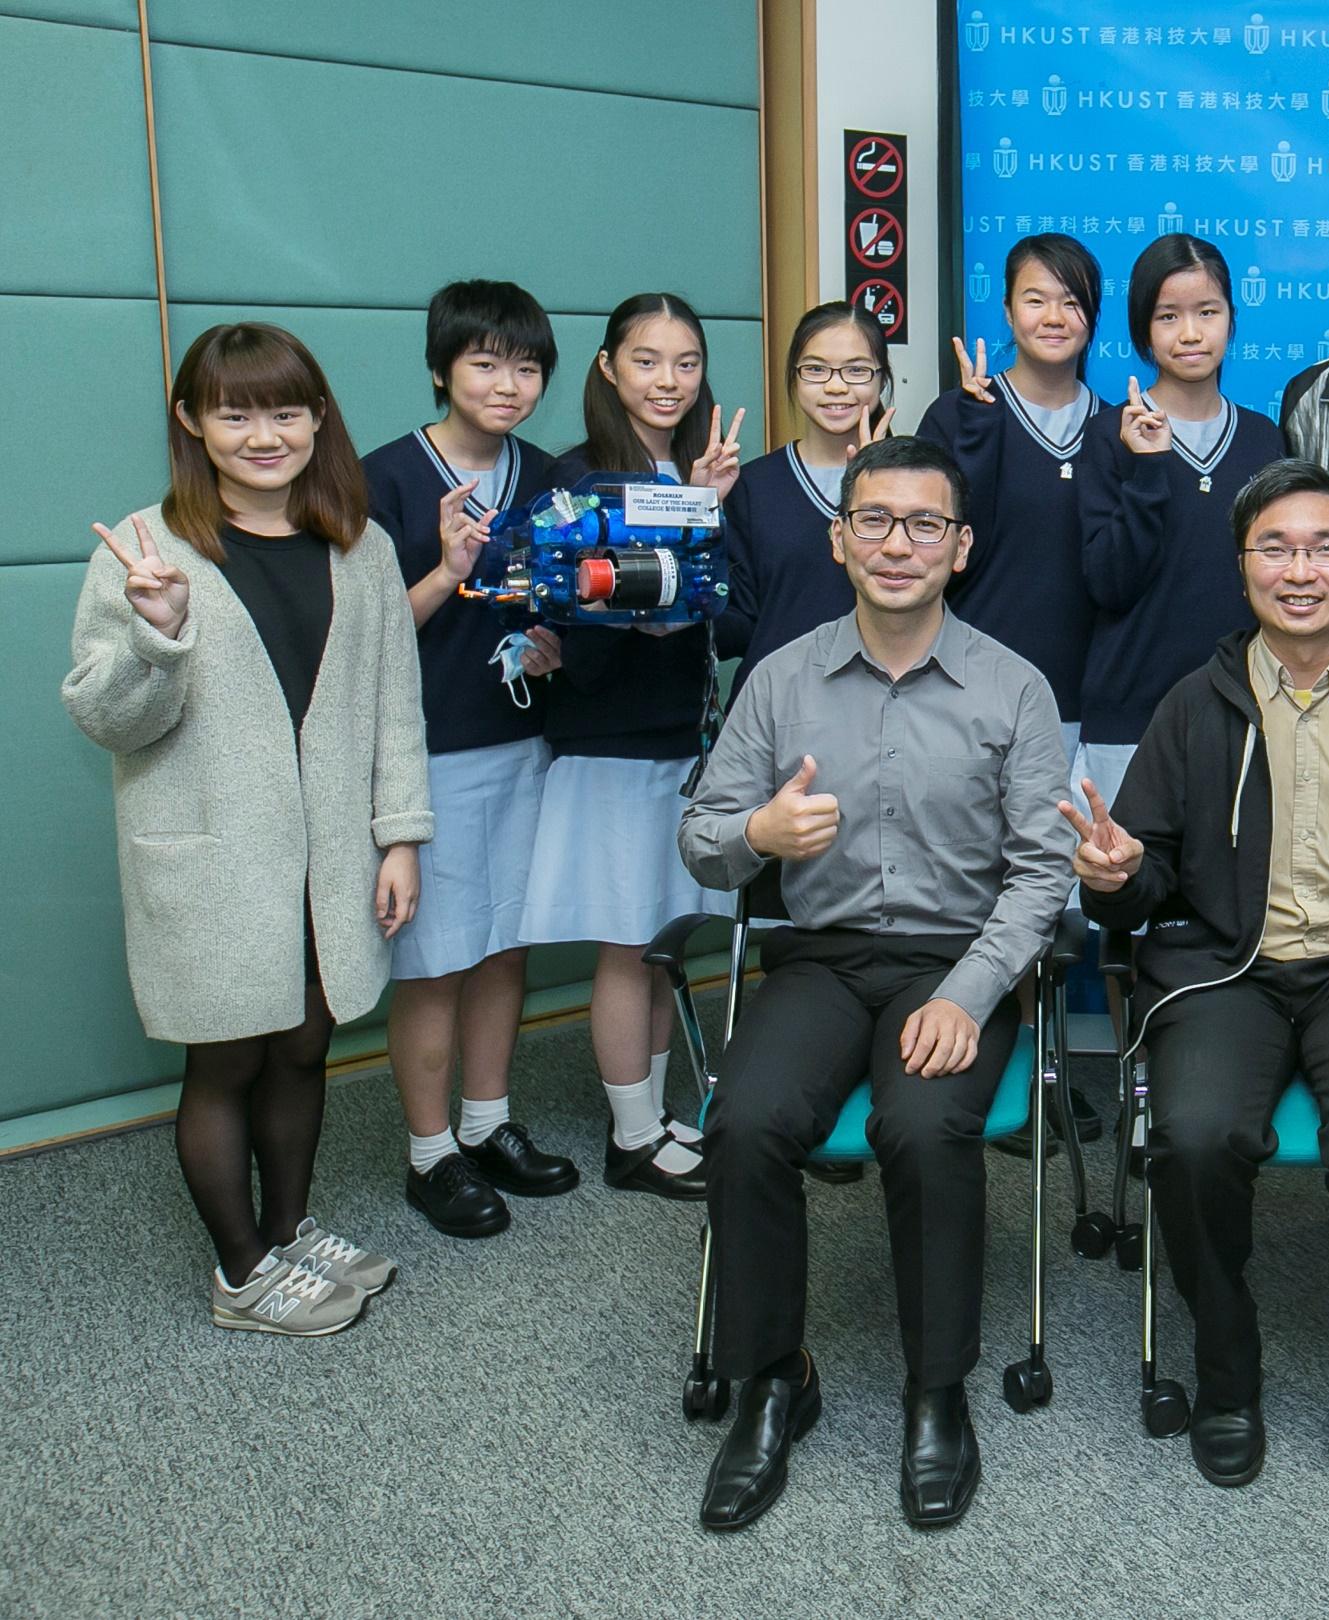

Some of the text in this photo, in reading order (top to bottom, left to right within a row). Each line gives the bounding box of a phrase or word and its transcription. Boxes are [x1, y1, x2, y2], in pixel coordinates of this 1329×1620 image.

[1001, 27, 1090, 45] HKUST
[1099, 27, 1232, 46] 香港科技大學
[968, 90, 1030, 108] 技大學
[1079, 91, 1168, 109] HKUST
[1176, 91, 1309, 111] 香港科技大學
[1029, 154, 1118, 172] HKUST
[1127, 154, 1259, 174] 香港科技大學
[1015, 216, 1145, 234] 香港科技大學
[1195, 218, 1284, 237] HKUST
[254, 1290, 300, 1323] N
